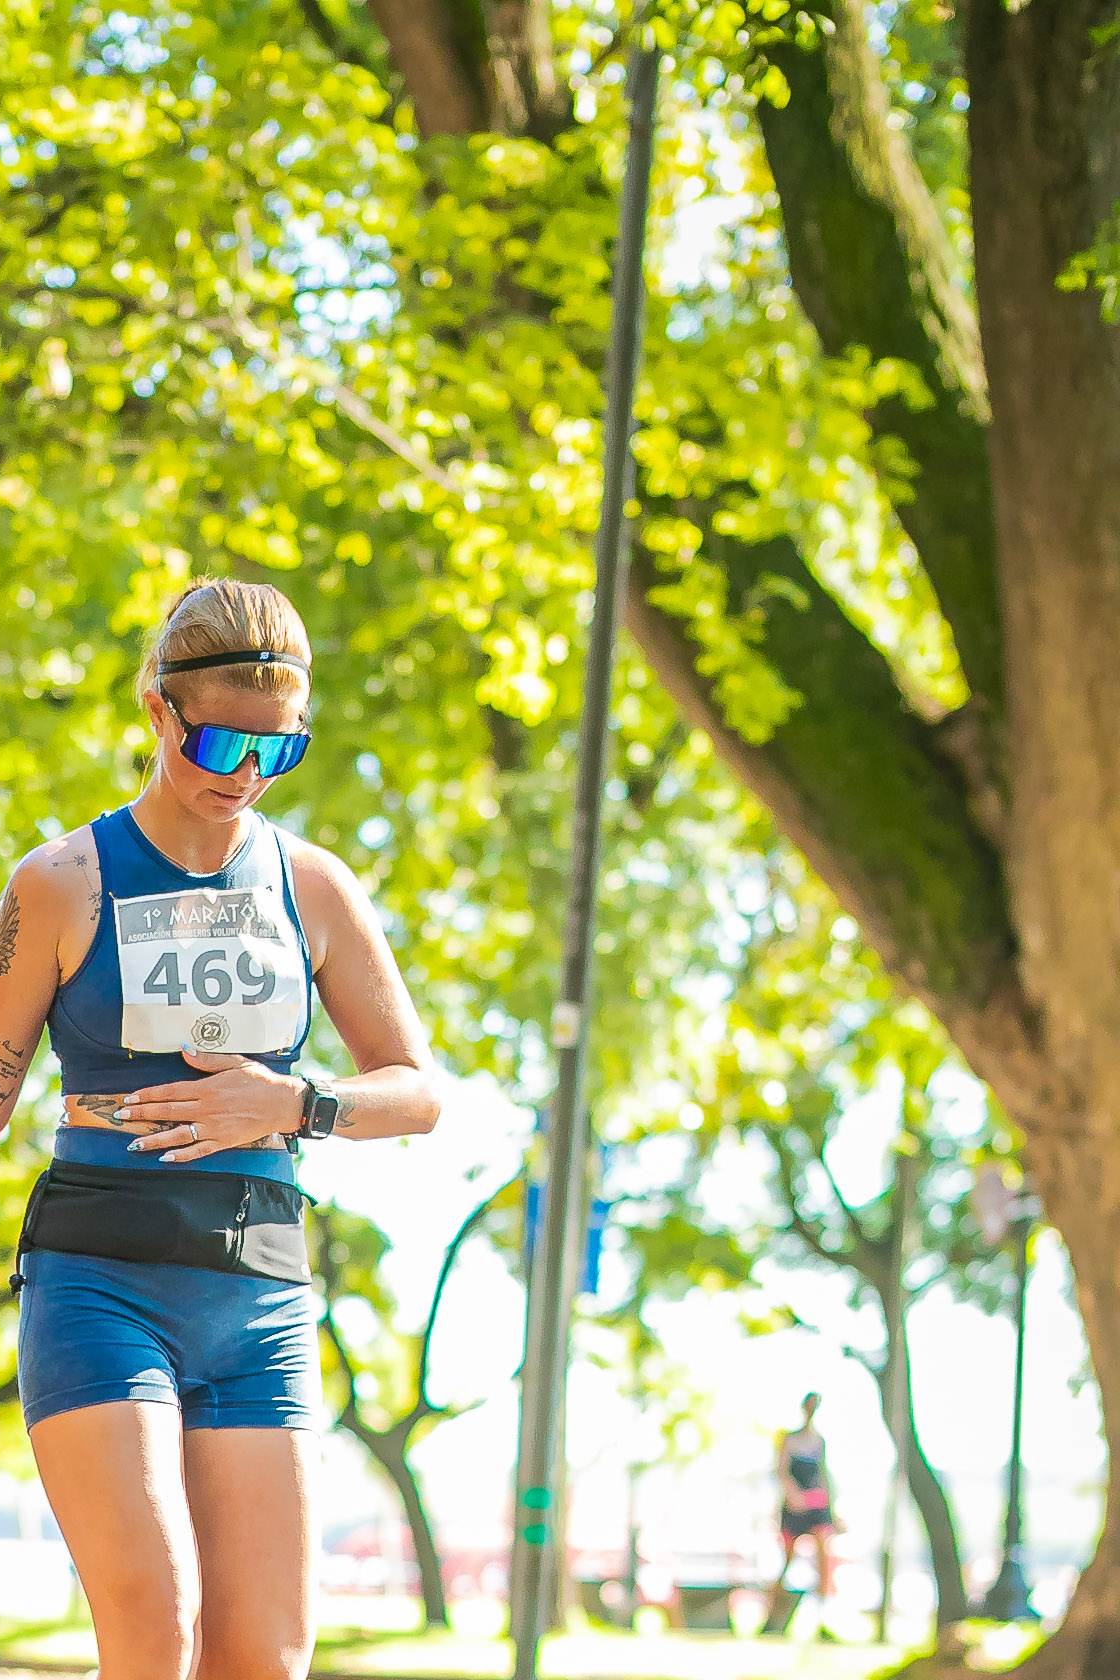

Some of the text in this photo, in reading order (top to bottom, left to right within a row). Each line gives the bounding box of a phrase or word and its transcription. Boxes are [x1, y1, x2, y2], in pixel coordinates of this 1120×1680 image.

[172, 928, 212, 938] BOMBEROS
[143, 949, 276, 1007] 469
[203, 1024, 220, 1038] 27
